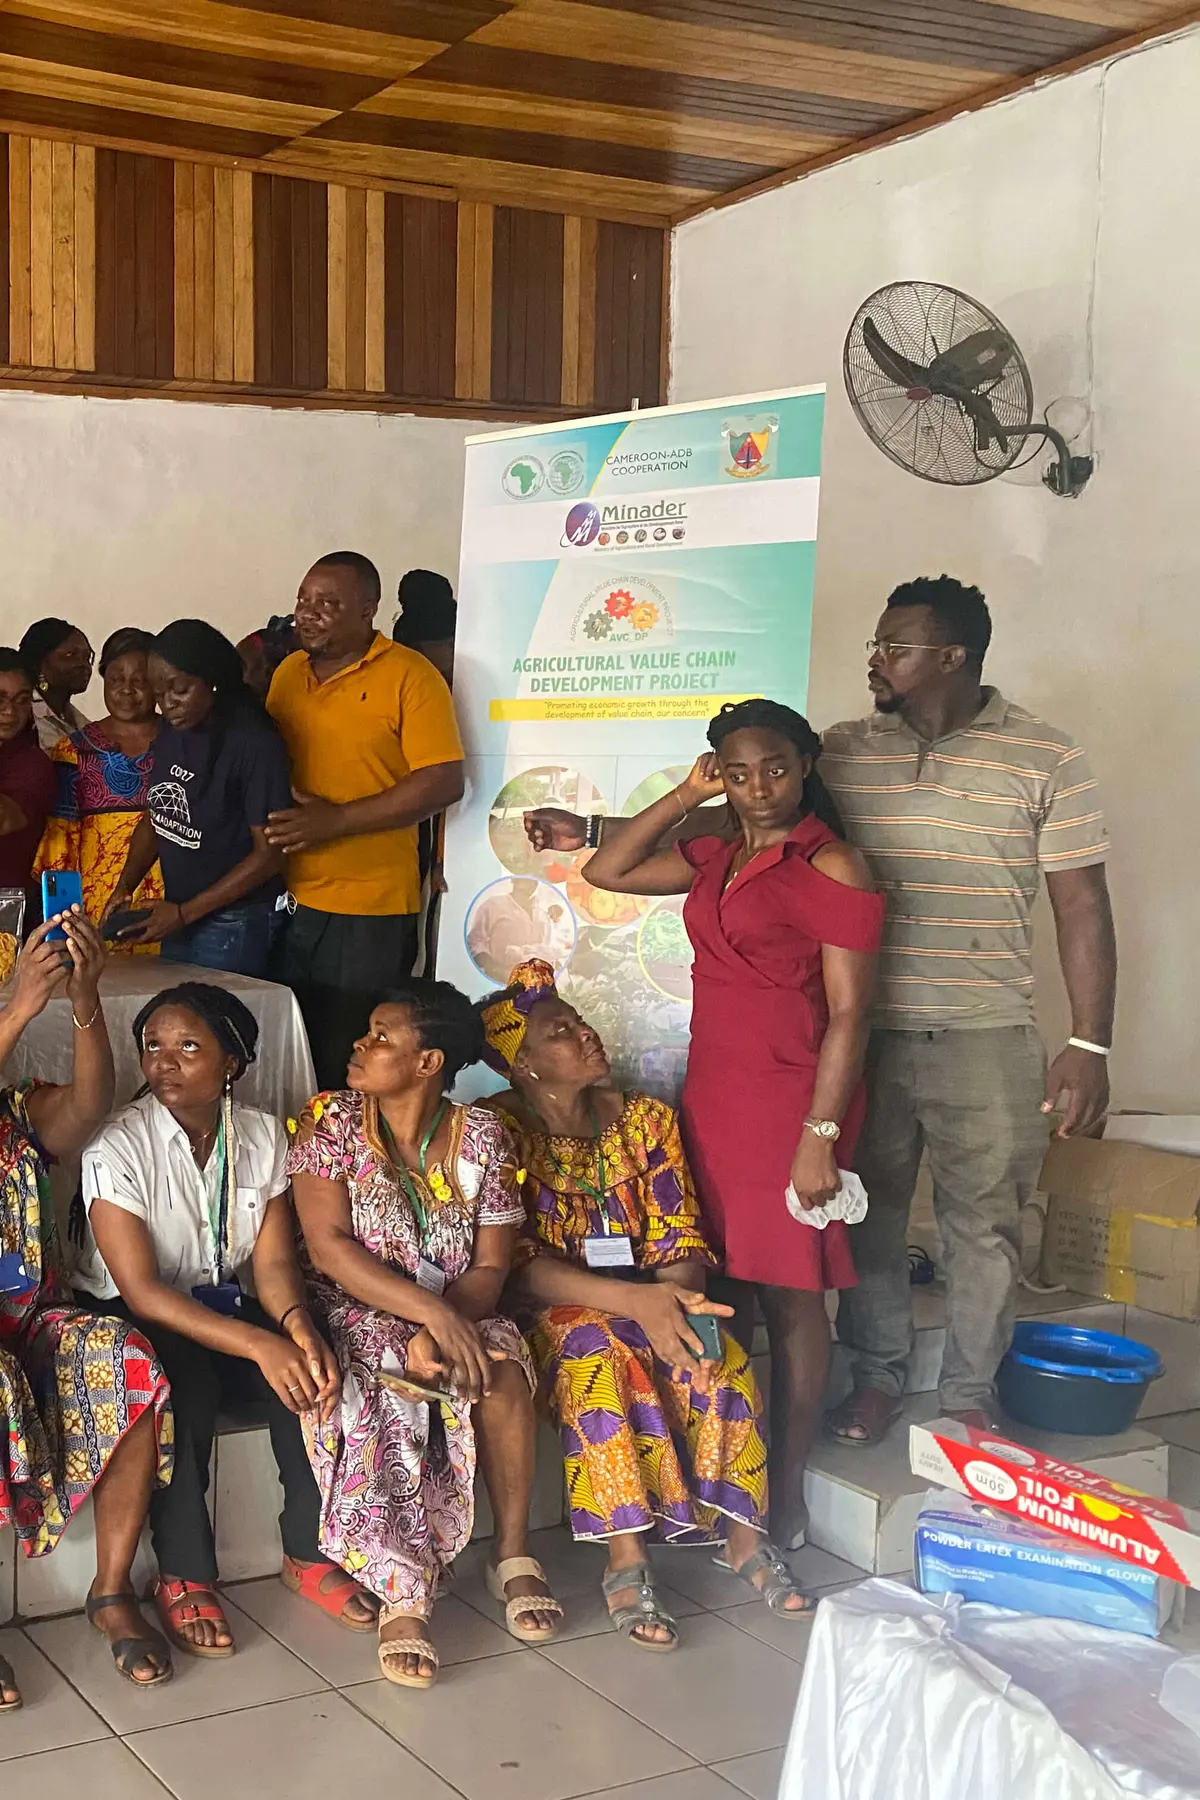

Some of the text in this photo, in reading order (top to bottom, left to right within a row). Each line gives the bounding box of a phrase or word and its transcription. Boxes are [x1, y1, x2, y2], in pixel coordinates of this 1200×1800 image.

[606, 448, 693, 466] CAMEROON-ADB
[611, 460, 689, 476] COOPERATION
[602, 500, 686, 522] Minader
[513, 650, 736, 673] AGRICULTURAL VALUE CHAIN
[530, 672, 720, 693] DEVELOPMENT PROJECT
[544, 698, 709, 711] "Promoting economic growth through the
[544, 709, 595, 720] development
[597, 709, 606, 718] of
[608, 709, 628, 718] value
[656, 709, 671, 717] our
[673, 707, 711, 718] concern"
[1044, 1459, 1100, 1486] FOIL
[1019, 1475, 1075, 1512] FOIL
[1017, 1496, 1161, 1565] ALUMINIUM
[923, 1530, 1156, 1585] POWDER LATEX EXAMINATION GLOVES
